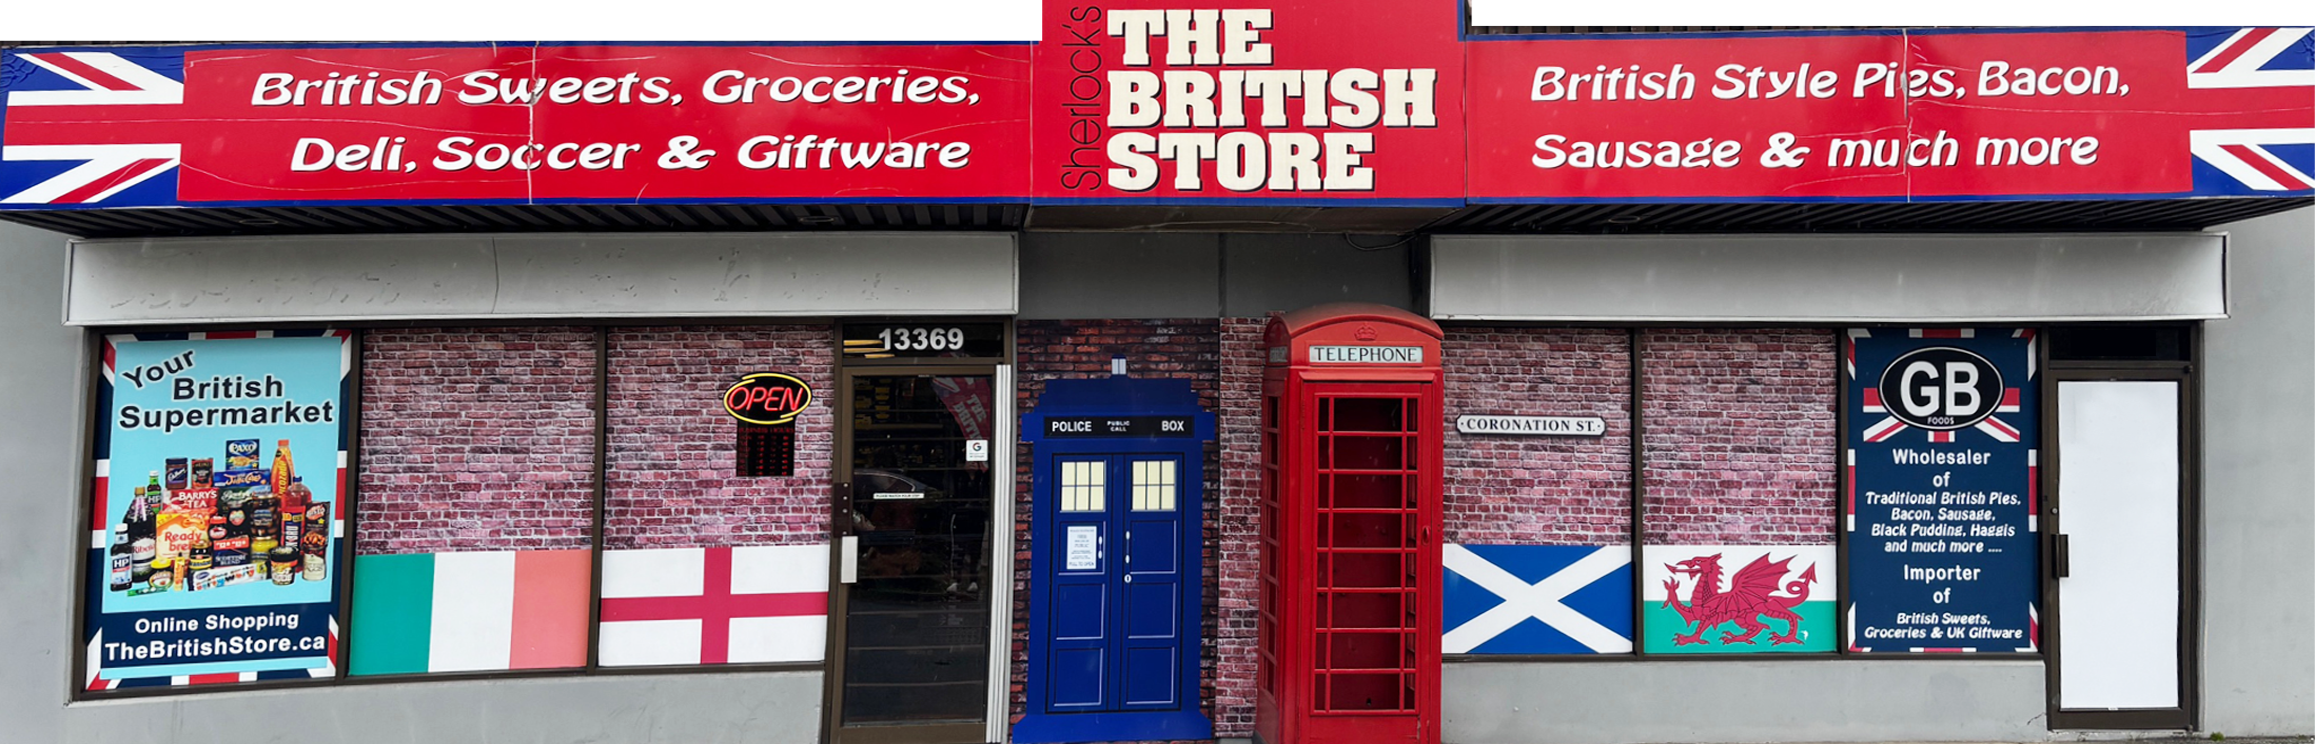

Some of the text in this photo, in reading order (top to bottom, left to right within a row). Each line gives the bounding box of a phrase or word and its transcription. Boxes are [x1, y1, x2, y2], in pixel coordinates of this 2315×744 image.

[1107, 9, 1274, 66] THE
[251, 69, 980, 106] British Sweets, Groceries,
[1531, 61, 2130, 101] British Style Pies, Bacon,
[1061, 5, 1101, 190] Sherlock's
[1107, 68, 1438, 128] BRITISH
[291, 134, 971, 172] Deli, Soccer & Giftware
[1531, 130, 2099, 169] Sausage & much more
[1107, 131, 1374, 191] STORE
[879, 327, 964, 350] 13369
[1314, 347, 1418, 362] TELEPHONE
[122, 350, 195, 389] Your
[173, 375, 283, 400] British
[1901, 361, 1981, 417] GB
[729, 387, 803, 411] OPEN
[119, 400, 333, 432] Supermarket
[1927, 417, 1955, 425] FOODS
[1052, 421, 1092, 432] POLICE
[1161, 420, 1185, 431] BOX
[1466, 418, 1595, 432] CORONATION ST.
[231, 443, 255, 453] PAXO
[1892, 448, 1991, 465] Wholesaler
[1932, 471, 1951, 487] of
[179, 490, 217, 501] BARRY'S
[1866, 491, 2021, 506] Traditional British Pies,
[1891, 508, 1996, 521] Bacon, Sausage,
[164, 531, 202, 543] Ready
[1871, 523, 2015, 538] Black Pudding, Haggis
[169, 541, 192, 553] bre
[1884, 540, 1907, 552] and
[1911, 540, 1946, 553] much
[1949, 543, 1984, 553] more
[114, 558, 128, 568] HP
[1904, 564, 1981, 584] Importer
[1933, 588, 1951, 604] of
[134, 612, 299, 634] Online Shopping
[1897, 613, 1991, 625] British Sweets,
[1864, 627, 2023, 639] Groceries & UK Giftware
[104, 635, 325, 661] TheBritishStore.ca
